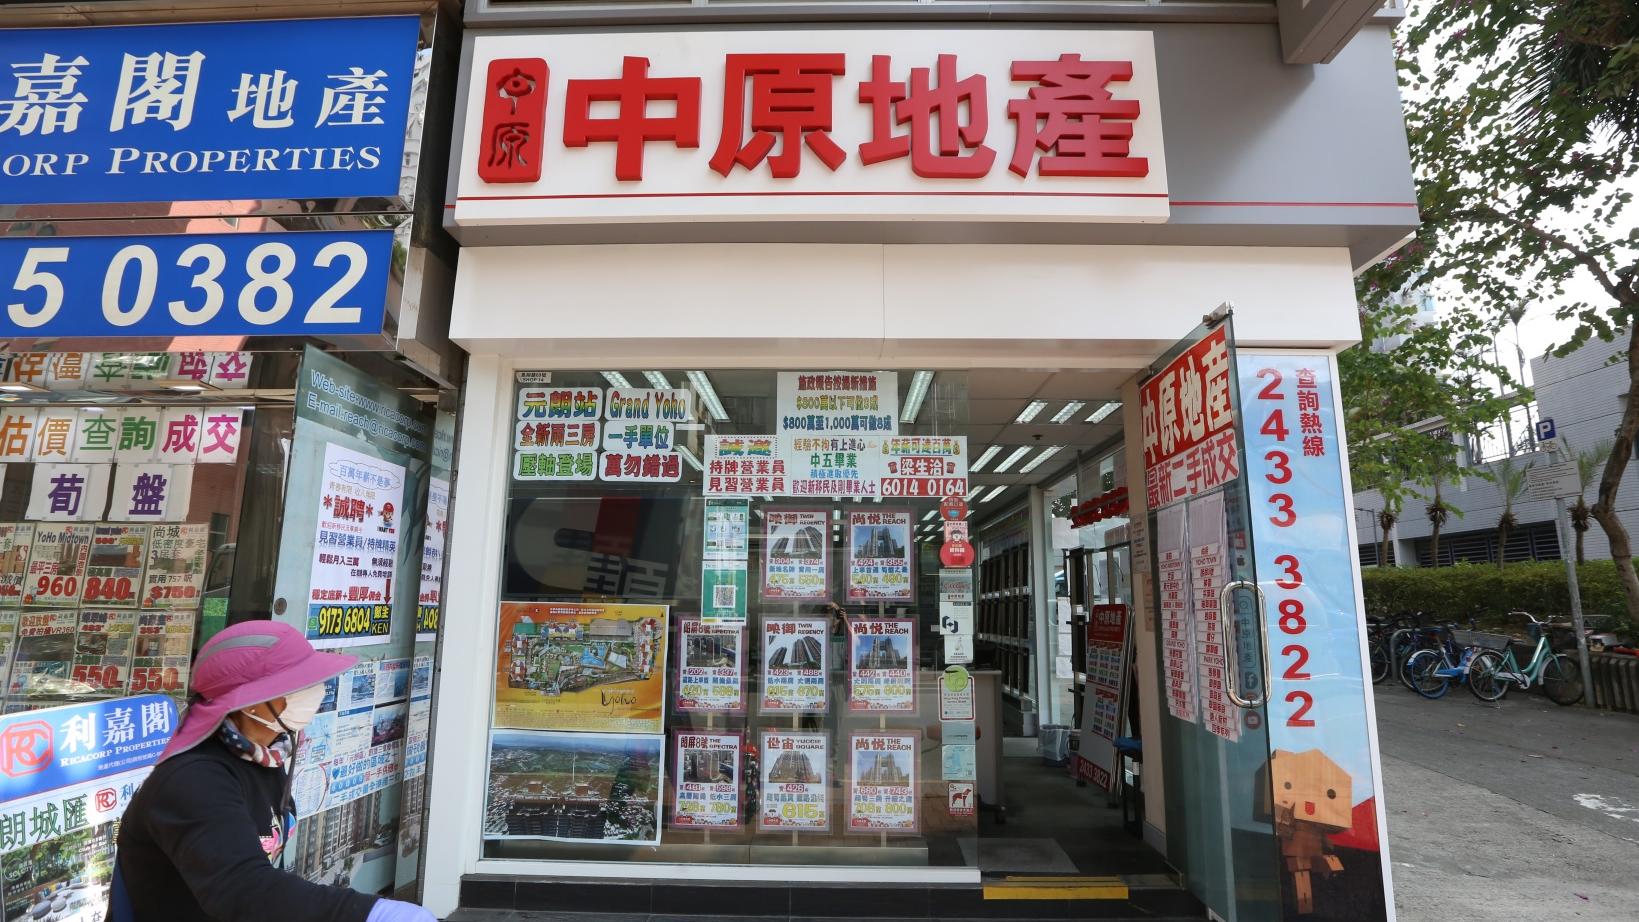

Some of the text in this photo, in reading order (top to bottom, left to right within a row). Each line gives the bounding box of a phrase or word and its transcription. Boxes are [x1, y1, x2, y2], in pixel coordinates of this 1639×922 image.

[562, 52, 1149, 182] 中原地產
[2, 146, 381, 177] ORP PROPERTIES
[7, 241, 368, 328] 5 0382
[522, 390, 598, 418] 元朗站
[610, 391, 686, 419] Grand Yoho
[1295, 368, 1325, 458] 查詢熱線
[0, 414, 242, 457] 估價查詢成交
[520, 422, 595, 447] 全新兩三房
[608, 424, 669, 449] 一手單位
[1538, 421, 1552, 439] P
[518, 452, 594, 476] 壓軸登場
[604, 454, 679, 477] 萬勿錯過
[709, 460, 785, 474] 持牌營業員
[810, 453, 857, 469] 中五畢業
[901, 458, 943, 476] 梁生洽
[1146, 431, 1239, 509] 最新二手成交
[709, 477, 785, 492] 見習營業員
[882, 479, 964, 495] 6014 0164
[333, 495, 366, 523] 誠聘
[37, 531, 57, 544] YoHo
[58, 532, 89, 545] Midtown
[36, 575, 78, 597] 960
[168, 575, 181, 583] 757
[319, 607, 371, 635] 9173 6804
[371, 622, 388, 634] KEN
[59, 701, 169, 753] 利嘉閣
[60, 750, 113, 768] RICACORP
[115, 736, 171, 755] PROPERTIES
